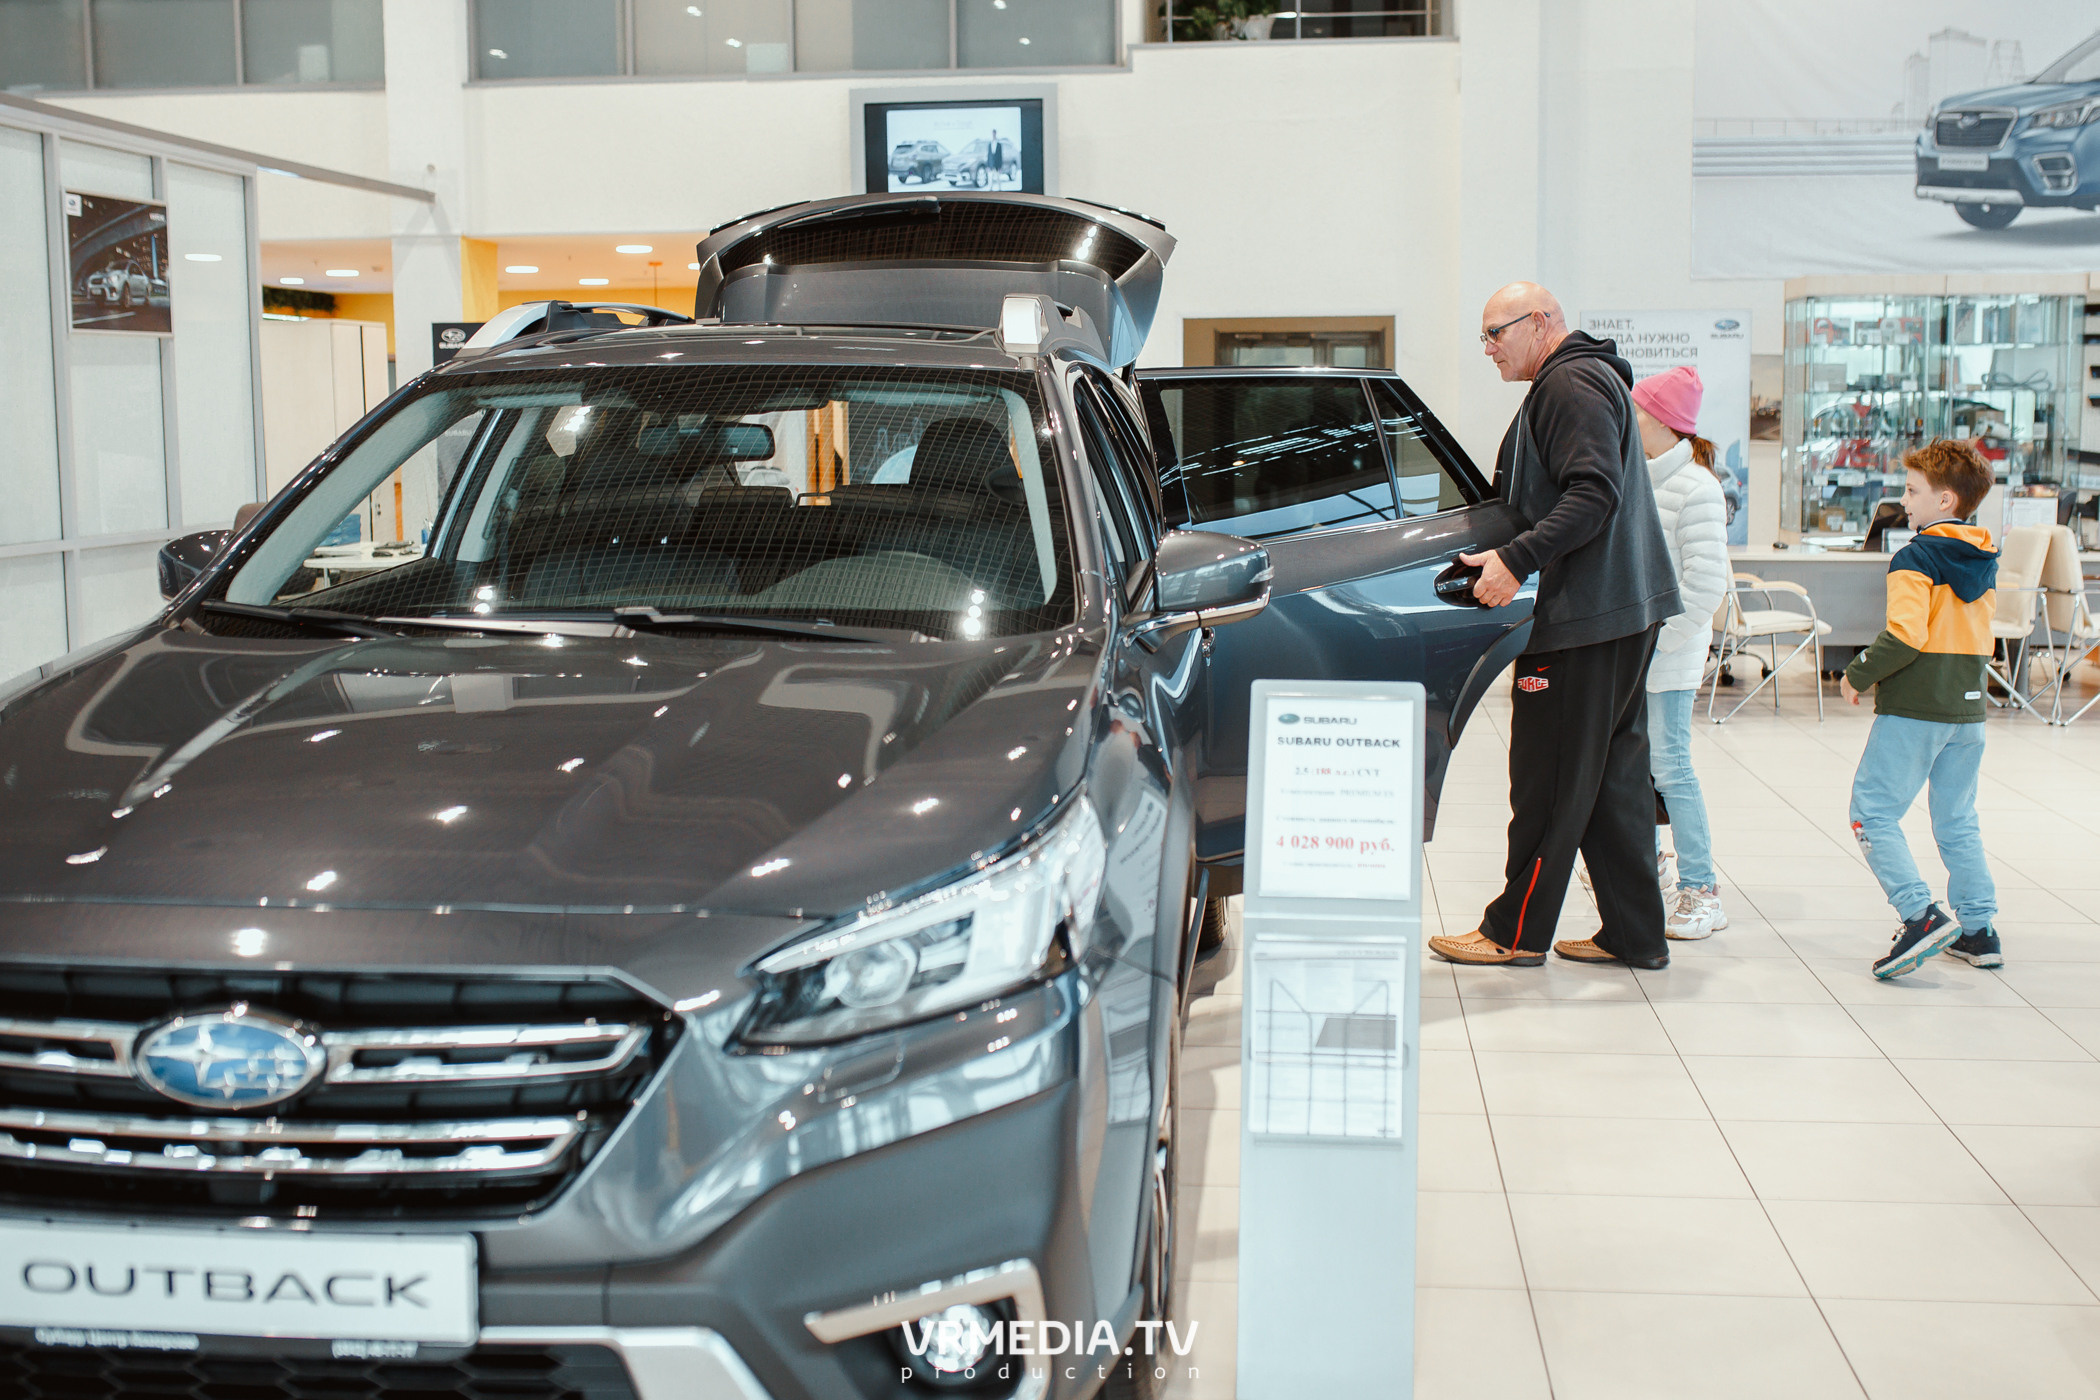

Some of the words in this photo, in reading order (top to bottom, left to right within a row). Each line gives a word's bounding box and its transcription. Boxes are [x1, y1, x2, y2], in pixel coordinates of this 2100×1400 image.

[1589, 319, 1635, 330] ЗНАЕТ,
[1592, 333, 1633, 345] ОГДА
[1638, 333, 1690, 345] НУЖНО
[1617, 347, 1698, 359] АНОВИТЬСЯ
[1304, 716, 1357, 725] SUBARU
[1278, 737, 1331, 746] SUBARU
[1336, 738, 1400, 748] OUTBACK
[1276, 836, 1284, 847] 4
[1291, 835, 1320, 849] 028
[1325, 837, 1354, 849] 900
[1360, 838, 1395, 855] руб.
[22, 1259, 429, 1309] OUTBACK
